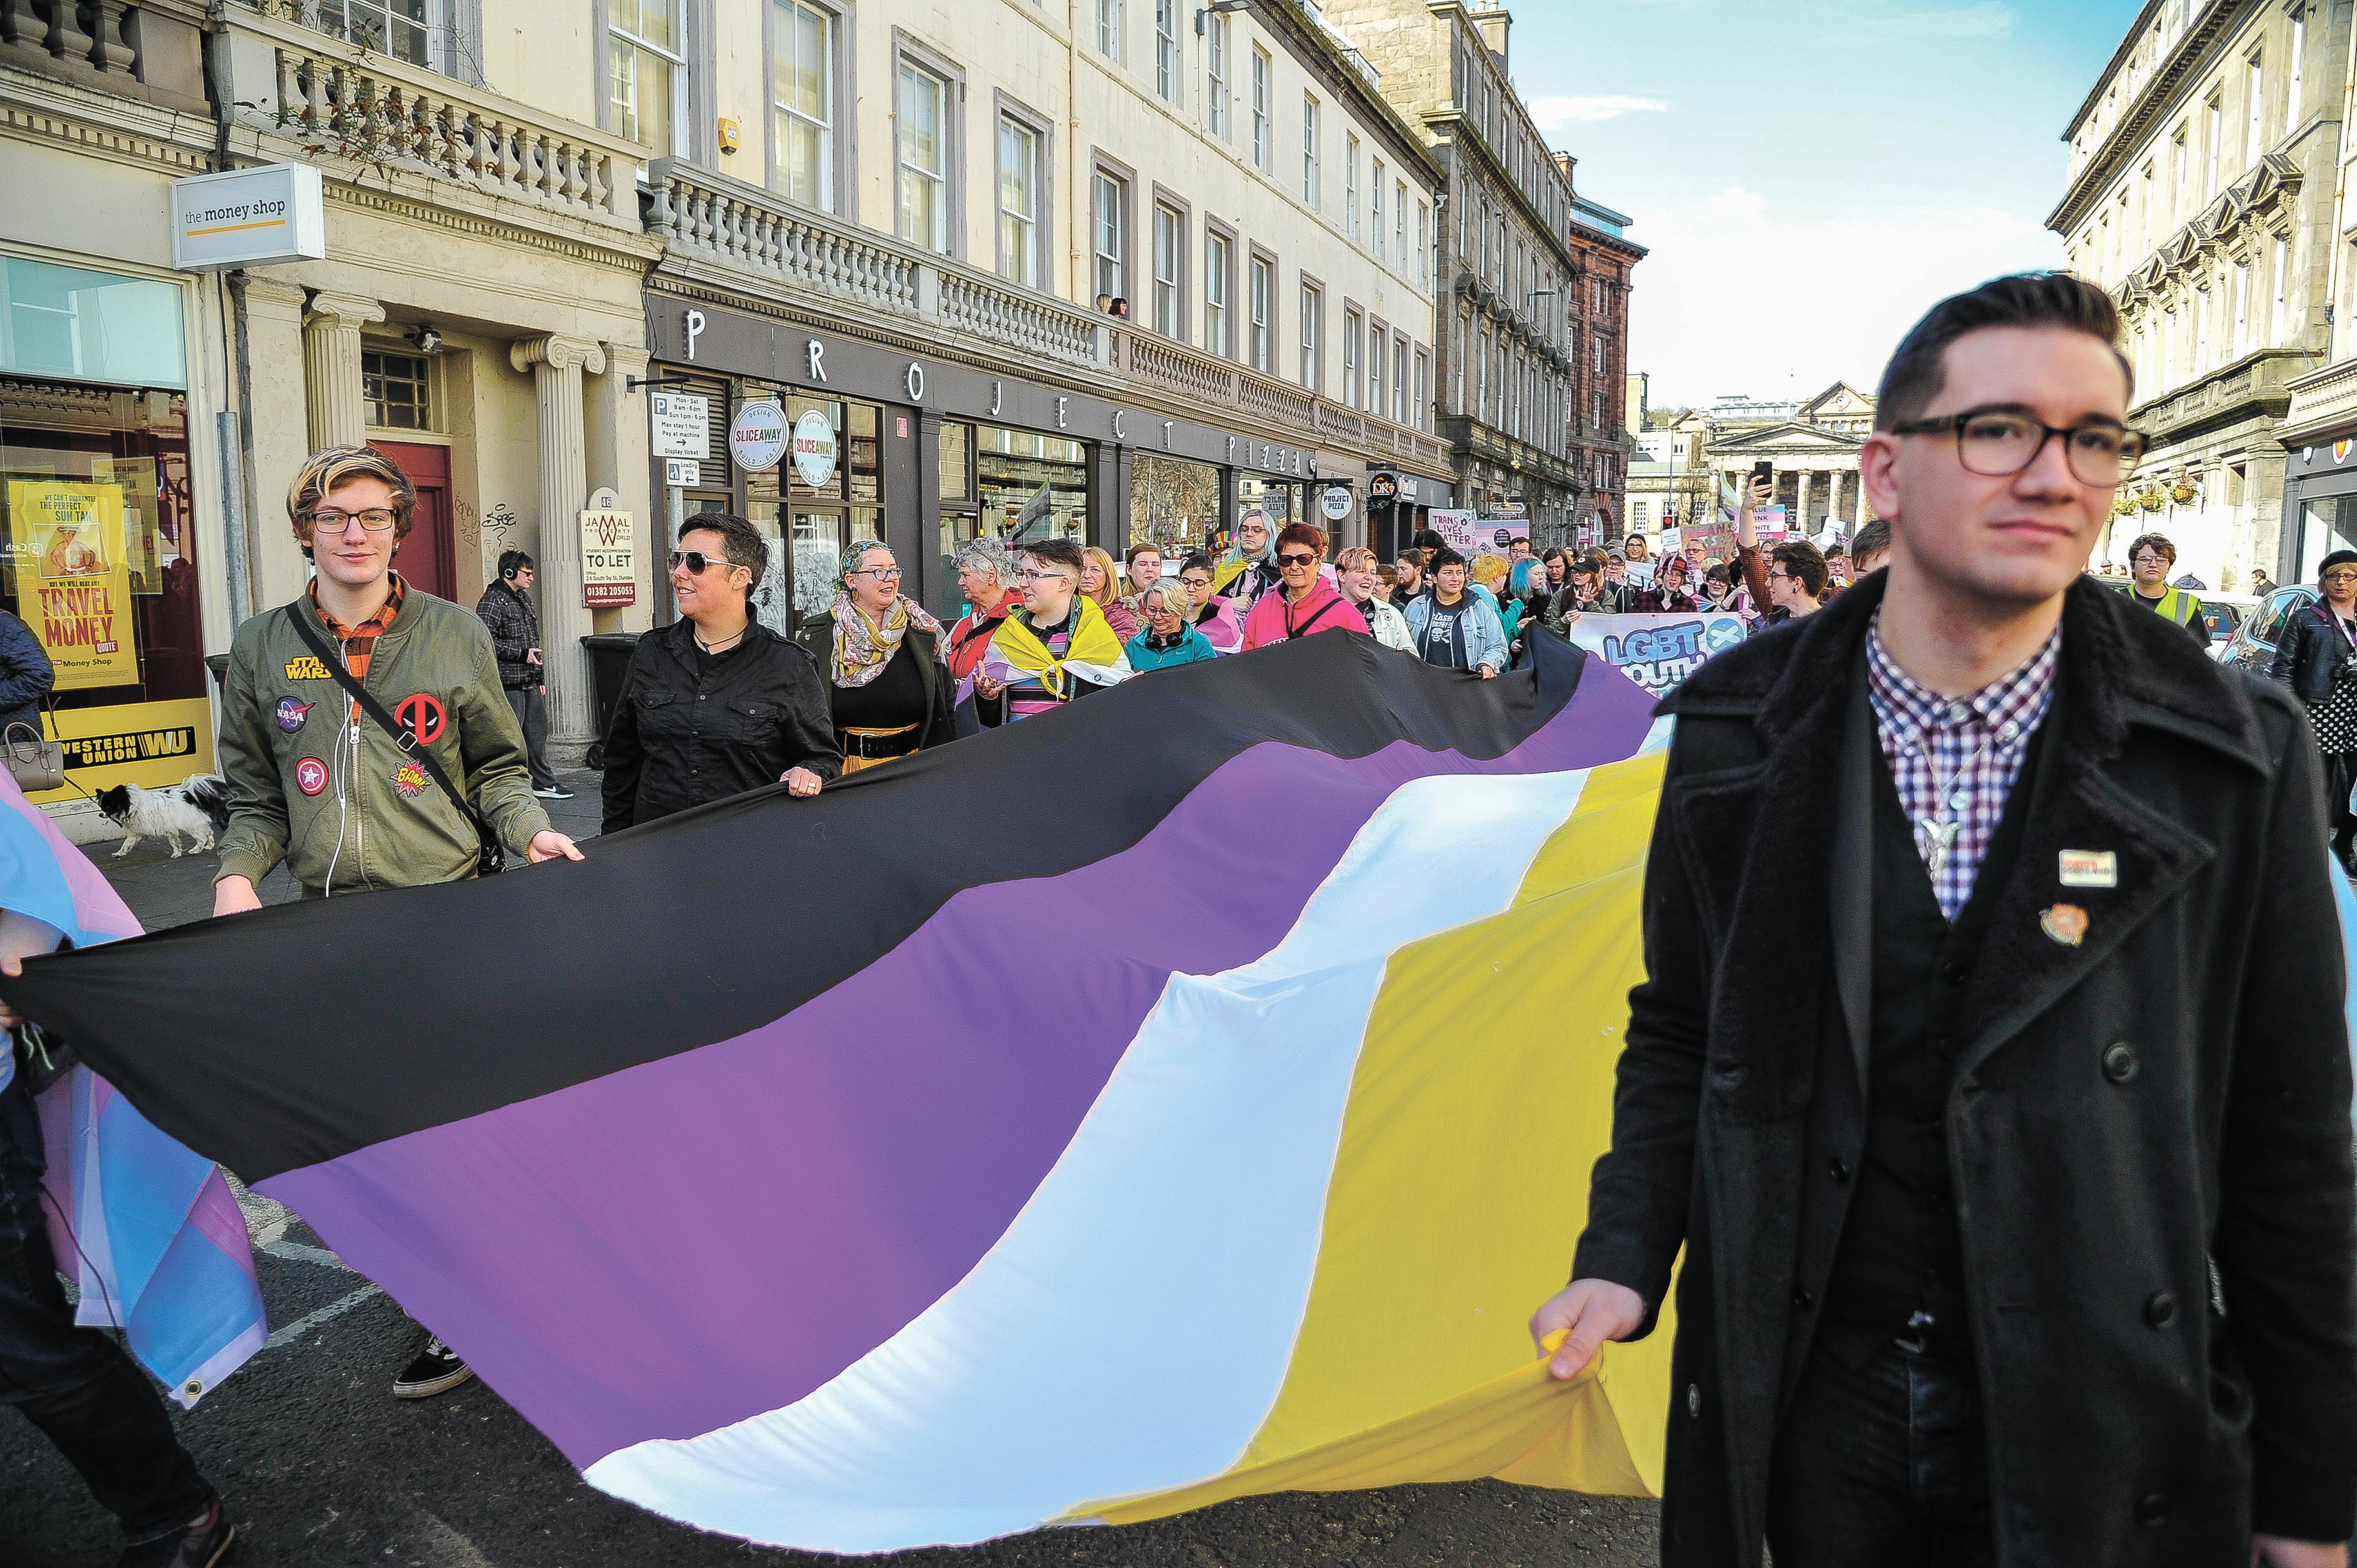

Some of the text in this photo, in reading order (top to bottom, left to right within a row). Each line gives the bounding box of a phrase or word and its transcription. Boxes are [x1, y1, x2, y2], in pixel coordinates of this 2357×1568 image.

[186, 199, 285, 224] the money shop
[687, 308, 1301, 476] PROJECT PIZZA
[657, 399, 666, 414] P
[749, 409, 773, 419] DESIGN
[805, 416, 825, 427] DESIGN
[735, 428, 782, 442] SLICEAWAY
[796, 438, 833, 456] SLICEAWAY
[738, 448, 778, 464] BUILD EAT
[800, 461, 831, 481] BUILD EAT
[53, 493, 69, 502] CAN'T
[601, 498, 611, 507] 46
[39, 501, 81, 510] THE PERFECT
[55, 510, 92, 522] SUN TAN
[1432, 515, 1458, 527] TRANS
[1437, 524, 1462, 535] LIVES
[1444, 534, 1470, 545] ATTER
[586, 554, 631, 568] TO LET
[587, 586, 634, 597] 01382 205055
[38, 587, 114, 617] TRAVEL
[44, 616, 113, 647] MONEY
[97, 642, 116, 653] QUOTE
[1605, 623, 1704, 665] LGBT
[292, 656, 325, 668] STA
[277, 708, 304, 722] NASA
[62, 736, 135, 755] WESTERN
[144, 730, 188, 756] WU
[83, 747, 137, 765] UNION
[397, 767, 426, 788] BAM!
